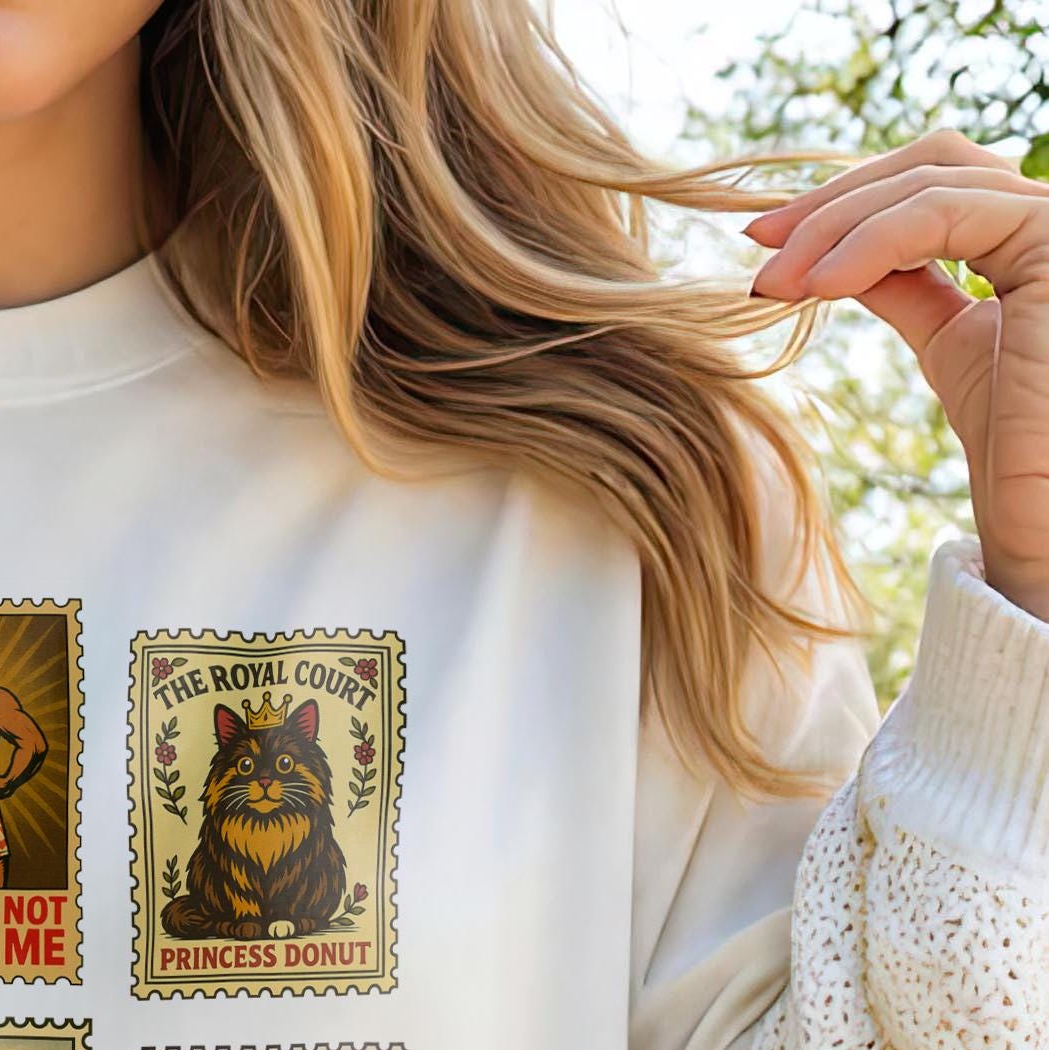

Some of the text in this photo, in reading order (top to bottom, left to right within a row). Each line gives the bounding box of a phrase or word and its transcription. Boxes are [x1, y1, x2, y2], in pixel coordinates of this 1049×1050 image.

[153, 660, 377, 711] THE ROYAL COURT
[4, 896, 68, 925] NOT
[5, 928, 66, 966] ME
[160, 941, 371, 971] PRINCESS DONUT
